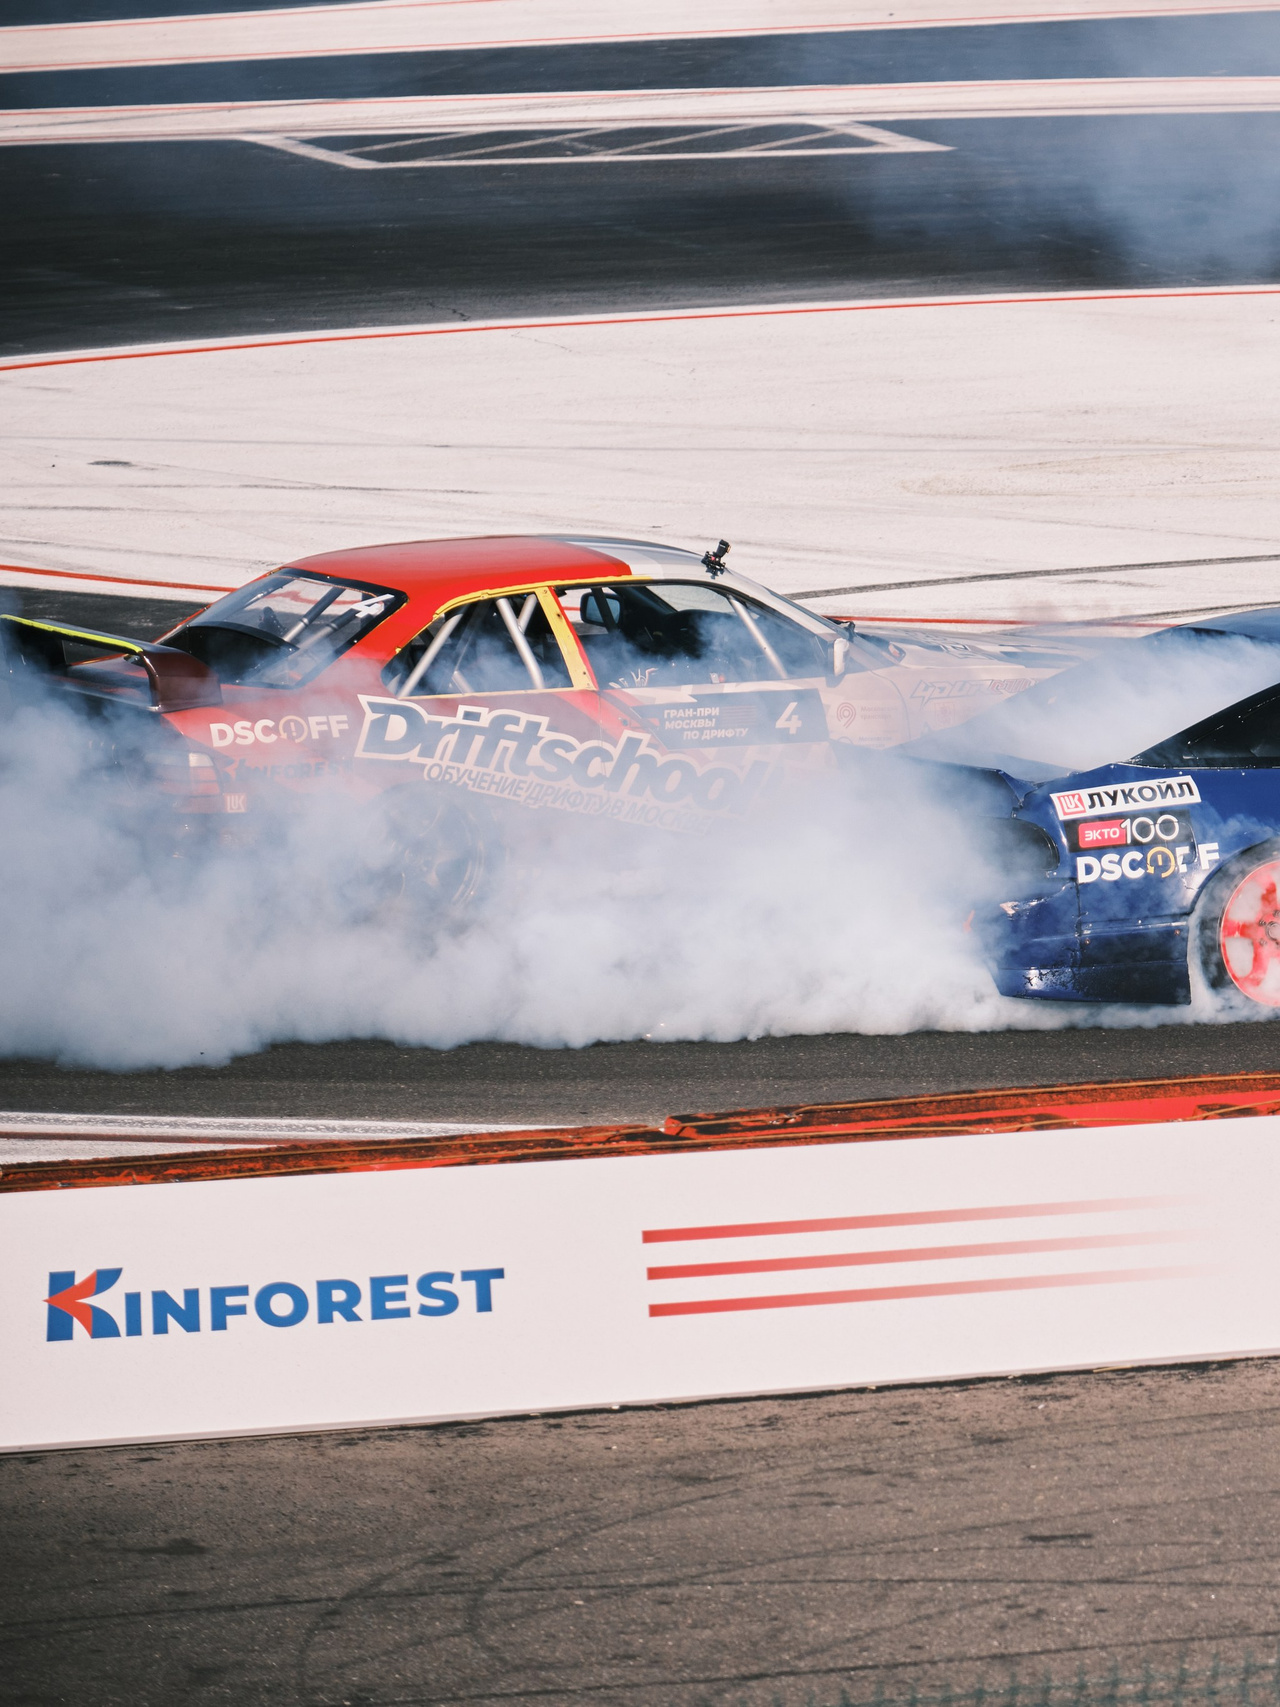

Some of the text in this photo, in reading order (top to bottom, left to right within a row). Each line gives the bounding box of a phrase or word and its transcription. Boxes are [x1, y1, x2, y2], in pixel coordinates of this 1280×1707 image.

[664, 707, 719, 718] ГРАН-ПРИ
[664, 718, 716, 729] МОСКВЫ
[775, 702, 803, 734] 4
[683, 728, 749, 740] ПО ДРИФТУ
[426, 763, 525, 798] ОБУЧЕНИЕ
[1087, 781, 1195, 810] ЛУКОЙЛ
[1084, 814, 1180, 844] ЭКТО 100
[42, 1267, 505, 1342] KINFOREST
